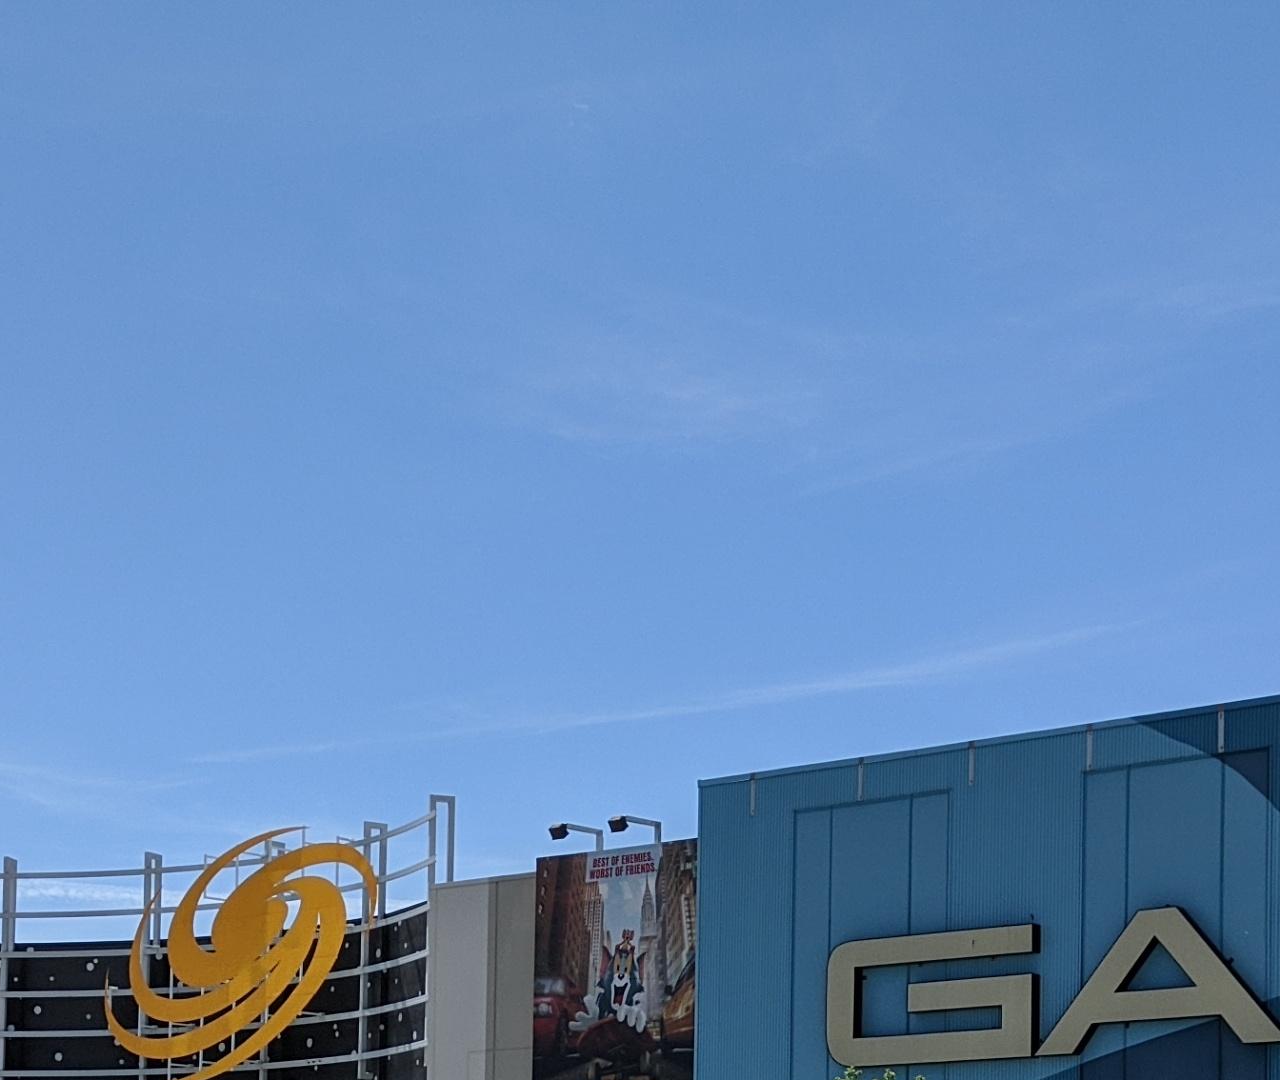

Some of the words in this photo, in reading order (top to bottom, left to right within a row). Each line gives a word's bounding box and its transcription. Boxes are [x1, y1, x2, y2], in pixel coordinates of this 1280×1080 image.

[592, 857, 609, 868] BEST
[611, 855, 620, 866] OF
[590, 867, 613, 879] WORST
[615, 866, 623, 877] OF
